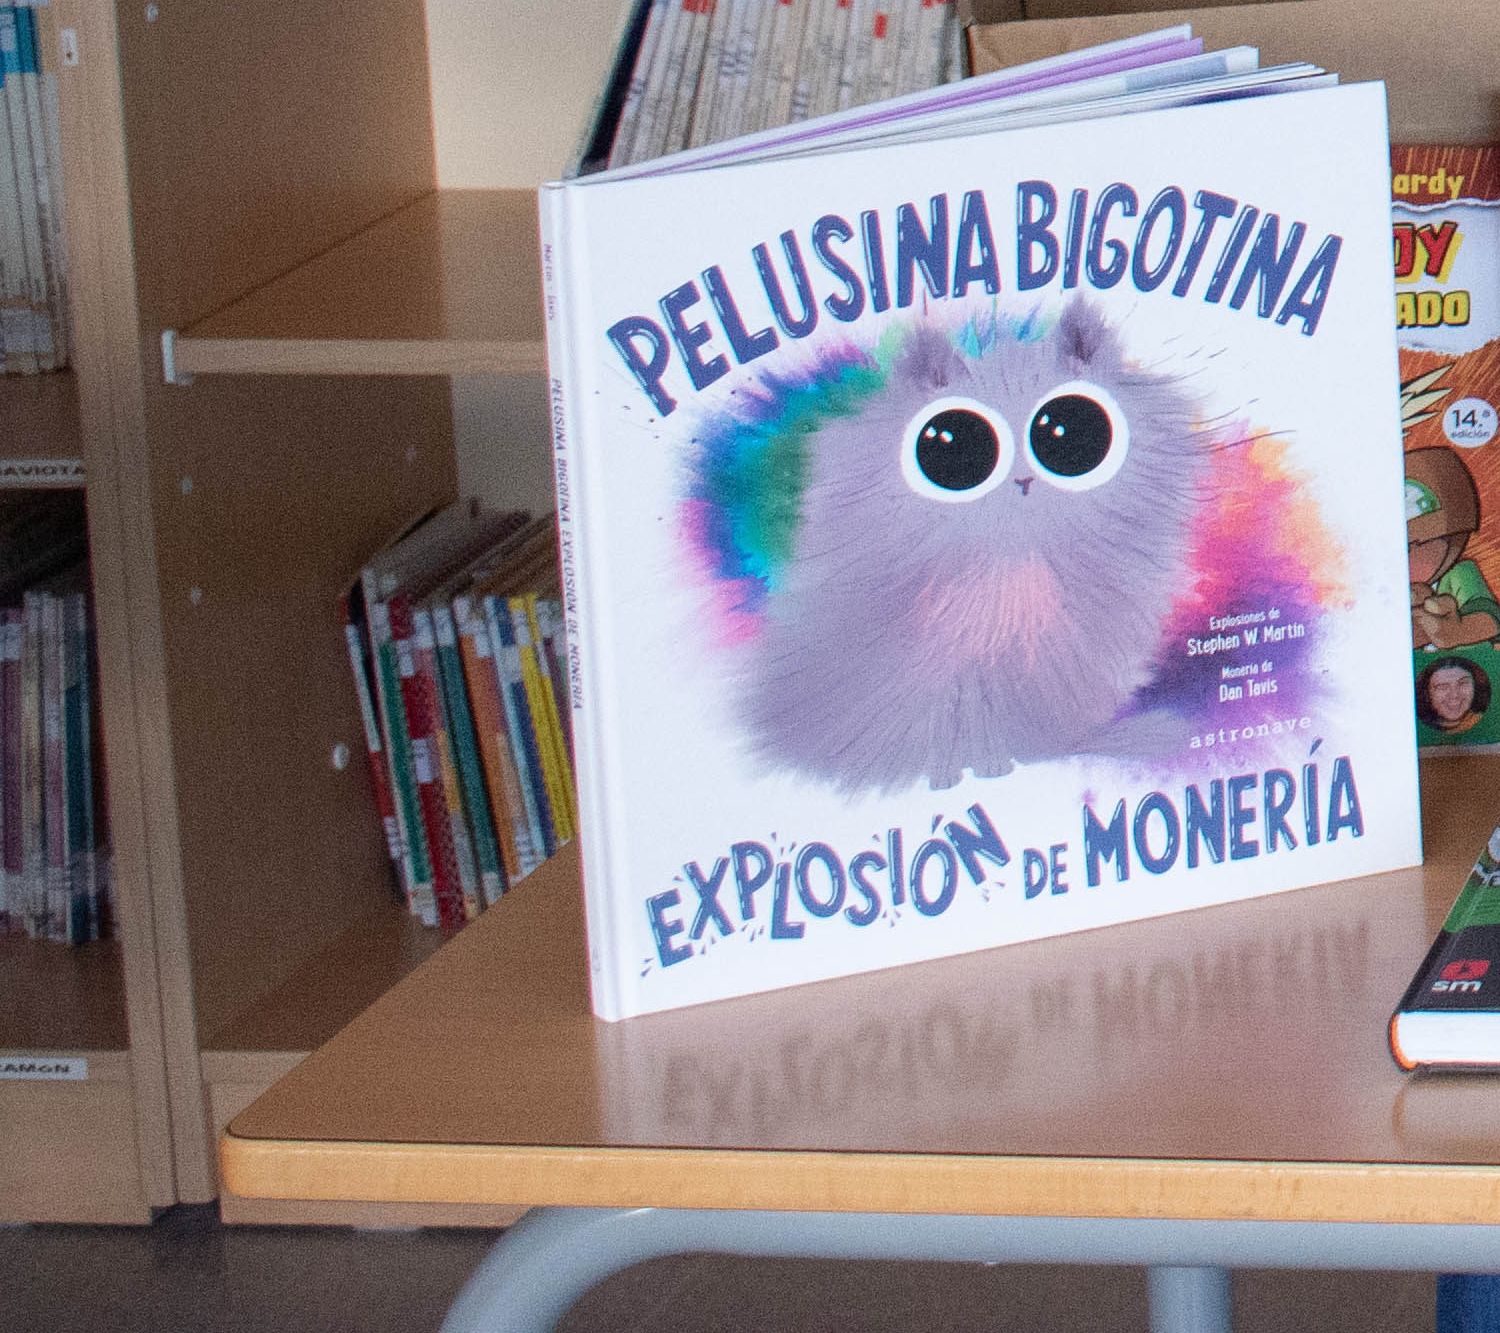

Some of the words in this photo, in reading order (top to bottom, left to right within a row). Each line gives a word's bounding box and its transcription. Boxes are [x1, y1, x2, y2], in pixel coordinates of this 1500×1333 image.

[607, 189, 1001, 417] PELUSINA
[1016, 179, 1344, 337] BIGOTINA
[1187, 633, 1240, 657] Stephen
[1263, 622, 1305, 643] Martin
[1219, 683, 1243, 703] Dan
[1247, 678, 1278, 697] Tavis
[1190, 716, 1313, 749] astronave
[643, 802, 1012, 969] EXPLOSIÓN
[1023, 843, 1069, 900] DE
[1081, 736, 1365, 888] MONERÍA
